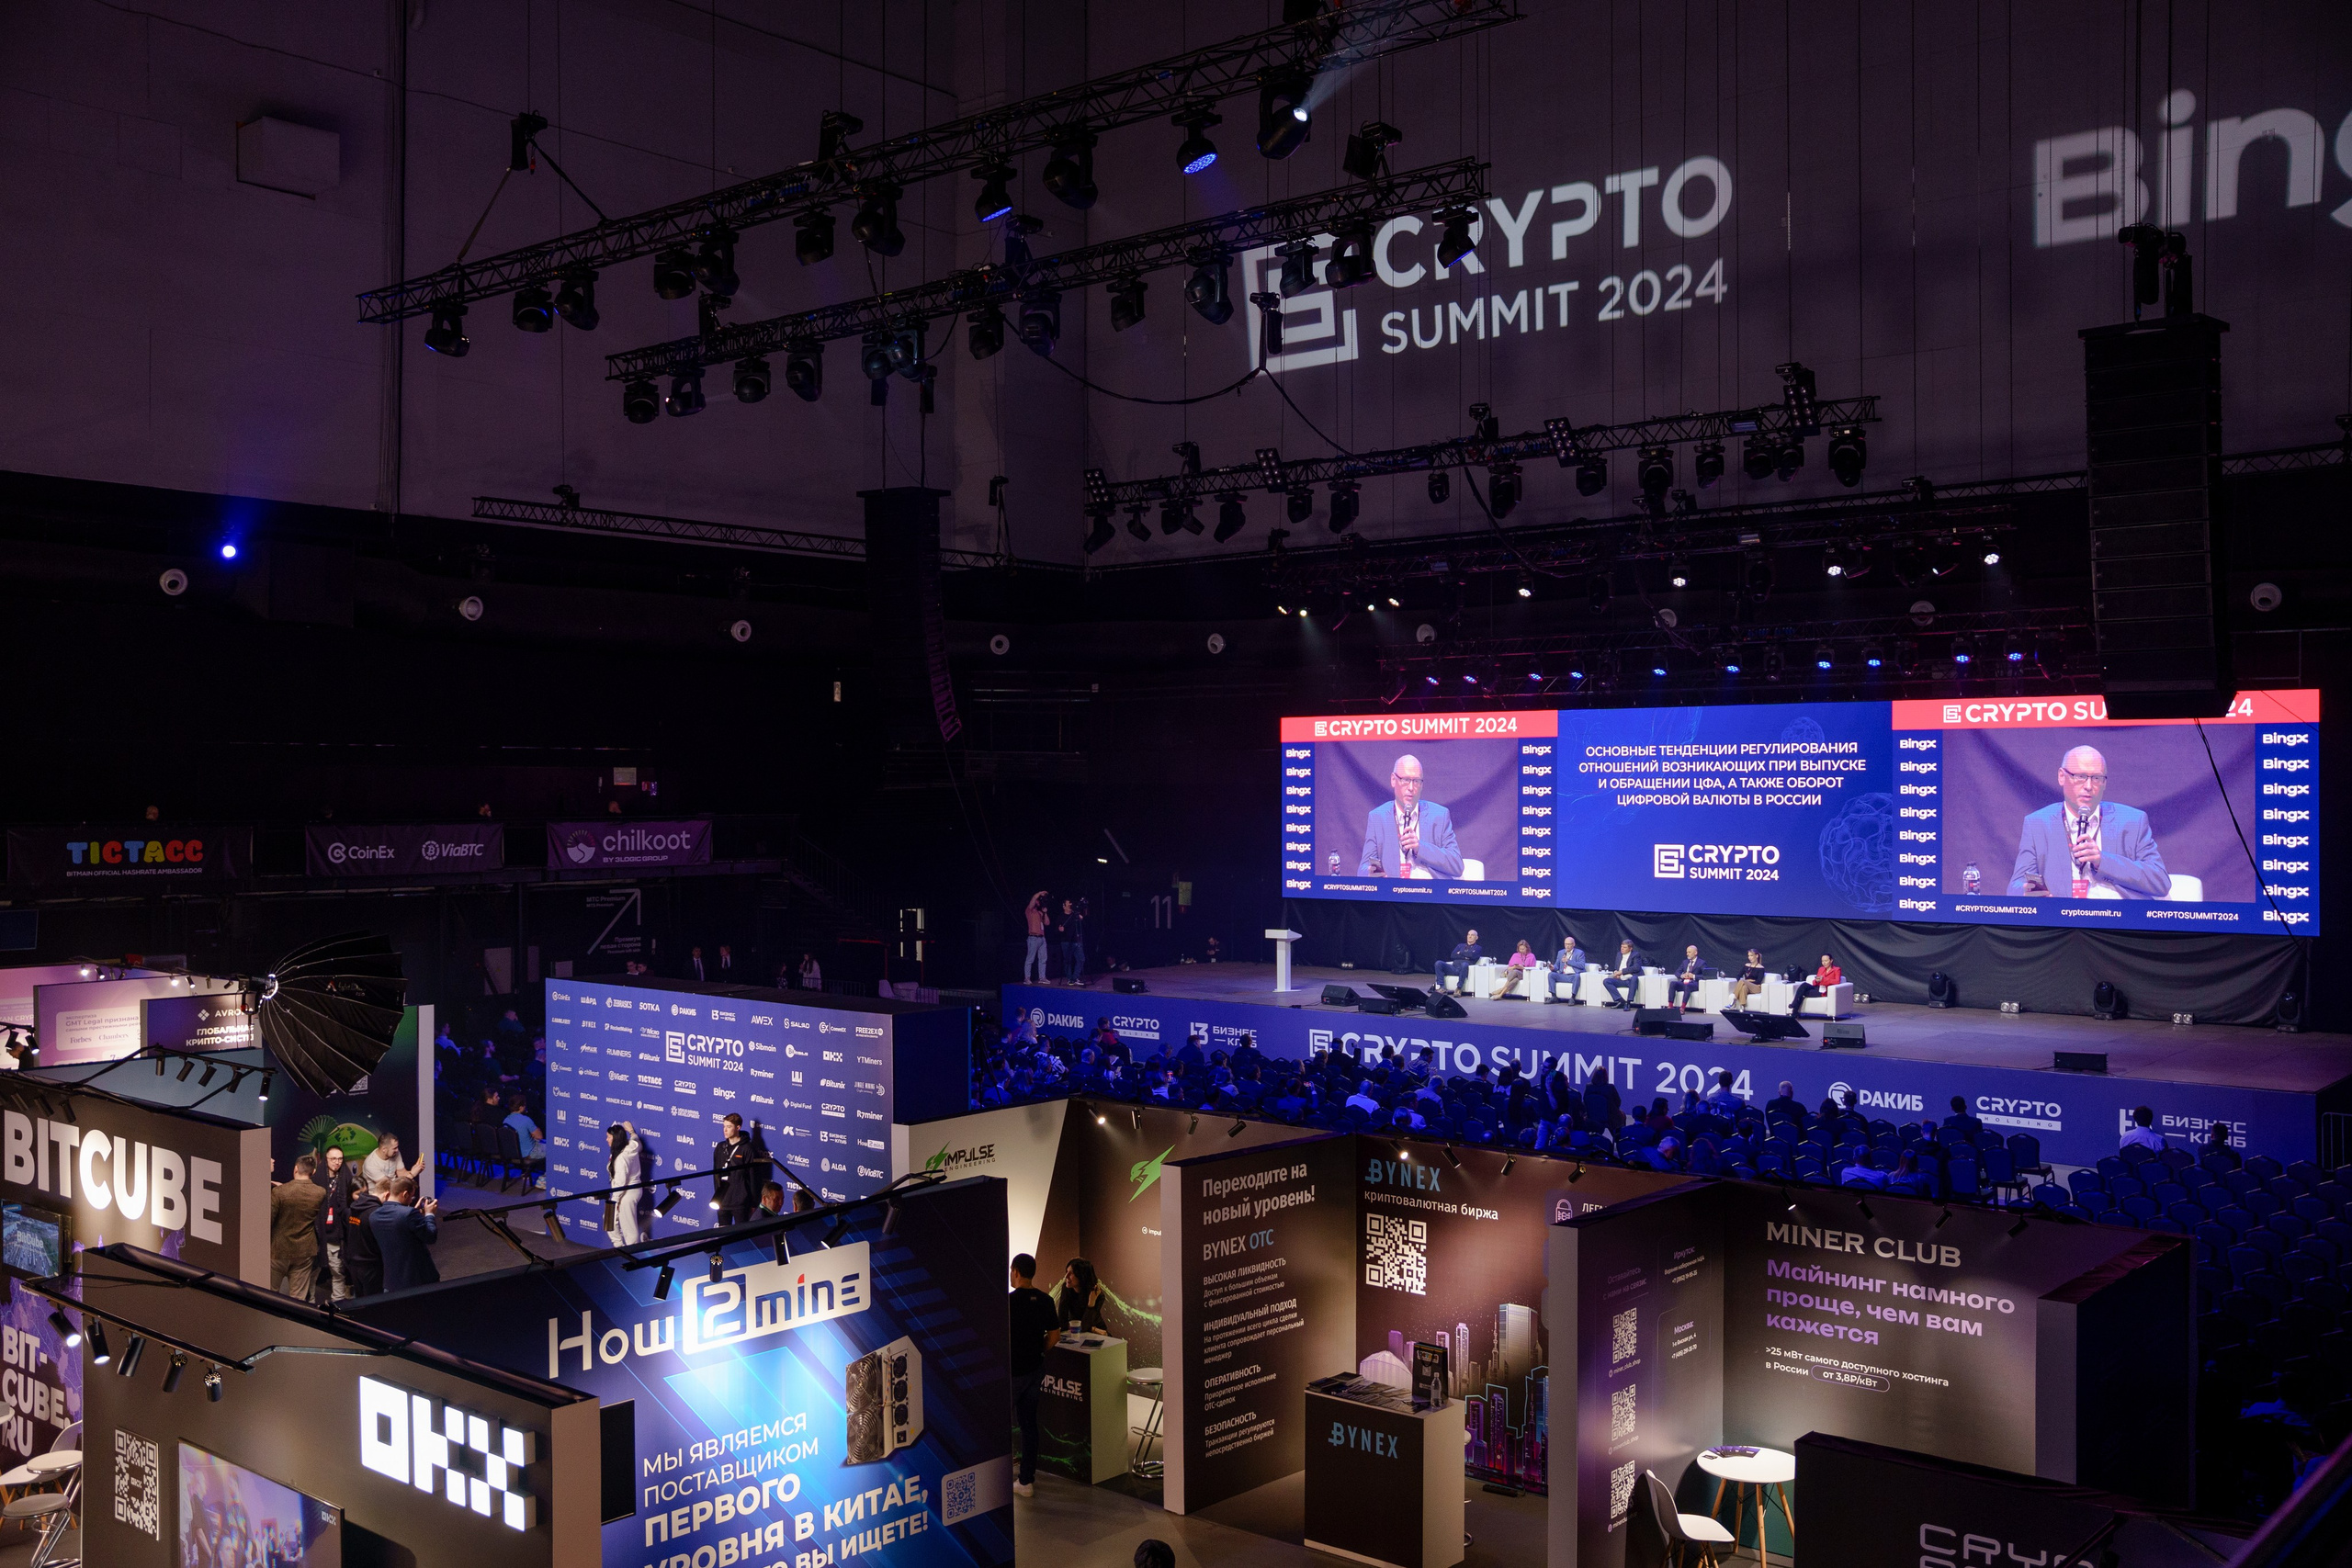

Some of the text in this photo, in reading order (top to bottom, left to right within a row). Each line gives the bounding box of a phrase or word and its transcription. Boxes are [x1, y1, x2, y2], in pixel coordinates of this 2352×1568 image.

[2033, 89, 2352, 250] Bin
[1380, 258, 1729, 355] SUMMIT 2024
[1965, 701, 2067, 723] CRYPTO
[1329, 716, 1518, 737] CRYPTO SUMMIT 2024
[1585, 742, 1858, 758] ОСНОВНЫЕ ТЕНДЕНЦИИ РЕГУЛИРОВАНИЯ
[1578, 759, 1866, 774] ОТНОШЕНИЙ ВОЗНИКАЮЩИХ ПРИ ВЫПУСКЕ
[1598, 776, 1844, 791] И ОБРАЩЕНИИ ЦФА, А ТАКЖЕ ОБОРОТ
[1617, 792, 1822, 807] ЦИФРОВОЙ ВАЛЮТЫ В РОССИИ
[441, 843, 484, 857] ViaBTC
[602, 829, 691, 852] chilkoot
[66, 840, 204, 866] TICTACC
[348, 845, 395, 860] CoinEx
[642, 854, 669, 863] GROUP
[1688, 844, 1781, 865] CRYPTO
[1689, 866, 1780, 882] SUMMIT 2024
[1955, 904, 2038, 915] #CRYPTOSUMMIT2024
[2061, 908, 2121, 919] cryptosummit.ru
[2146, 910, 2239, 921] #CRYPTOSUMMIT2024
[639, 1001, 660, 1012] SOTKA
[83, 1018, 104, 1026] Legal
[104, 1015, 140, 1024] признана
[751, 1015, 774, 1026] AWEX
[1113, 1015, 1159, 1030] CRYPTO
[70, 1035, 93, 1043] Forbes
[686, 1033, 744, 1057] CRYPTO
[687, 1054, 744, 1073] SUMMIT 2024
[856, 1056, 883, 1066] YTMiners
[674, 1079, 696, 1089] CRYPTO
[820, 1102, 845, 1113] CRYPTO
[1859, 1089, 1924, 1111] РАКИБ
[1976, 1095, 2062, 1117] CRYPTO
[1984, 1116, 2056, 1129] HOLDING
[944, 1144, 995, 1167] IMPULSE
[944, 1156, 996, 1172] ENGINEERING
[4, 1110, 222, 1245] BITCUBE
[831, 1163, 847, 1172] ALGA
[1365, 1158, 1441, 1192] BYNEX
[1203, 1163, 1307, 1198] Переходите на
[1203, 1185, 1316, 1225] новый уровень!
[1364, 1190, 1498, 1221] криптовалютная биржа
[1203, 1228, 1274, 1261] BYNEX OTC
[1766, 1221, 1962, 1268] MINER CLUB
[1203, 1257, 1286, 1286] ВЫСОКАЯ ЛИКВИДНОСТЬ
[1204, 1287, 1224, 1299] Доступ
[1227, 1279, 1254, 1291] большим
[1208, 1280, 1285, 1308] фиксированной стоимостью
[1767, 1259, 2016, 1314] Майнинг намного
[1204, 1298, 1297, 1332] ИНДИВИДУАЛЬНЫЙ ПОДХОД
[1279, 1311, 1298, 1323] сделки
[1767, 1288, 1983, 1337] проще, чем вам
[1204, 1342, 1227, 1355] клиента
[1266, 1317, 1305, 1337] персональный
[1767, 1313, 1880, 1346] кажется
[3, 1325, 48, 1373] BIT-
[1204, 1351, 1233, 1365] менеджер
[1204, 1363, 1261, 1389] ОПЕРАТИВНОСТЬ
[1773, 1361, 1809, 1376] России
[1822, 1371, 1835, 1380] от
[1783, 1349, 1804, 1360] мВт
[1804, 1353, 1839, 1368] самого
[1840, 1360, 1900, 1378] доступного
[1902, 1370, 1950, 1387] хостинга
[1204, 1371, 1277, 1402] Приоритетное исполнение
[1204, 1411, 1257, 1437] БЕЗОПАСНОСТЬ
[643, 1413, 807, 1477] МЫ ЯВЛЯЕМСЯ
[1204, 1430, 1238, 1448] Транзакции
[1204, 1427, 1274, 1458] непосредственно биржей
[1328, 1421, 1399, 1460] BYNEX
[359, 1375, 529, 1531] OKX
[644, 1438, 820, 1507] ПОСТАВЩИКОМ
[645, 1473, 801, 1548] ПЕРВОГО
[795, 1511, 815, 1541] В
[823, 1475, 929, 1532] КИТАЕ,
[842, 1511, 929, 1560] ИЩЕТЕ!
